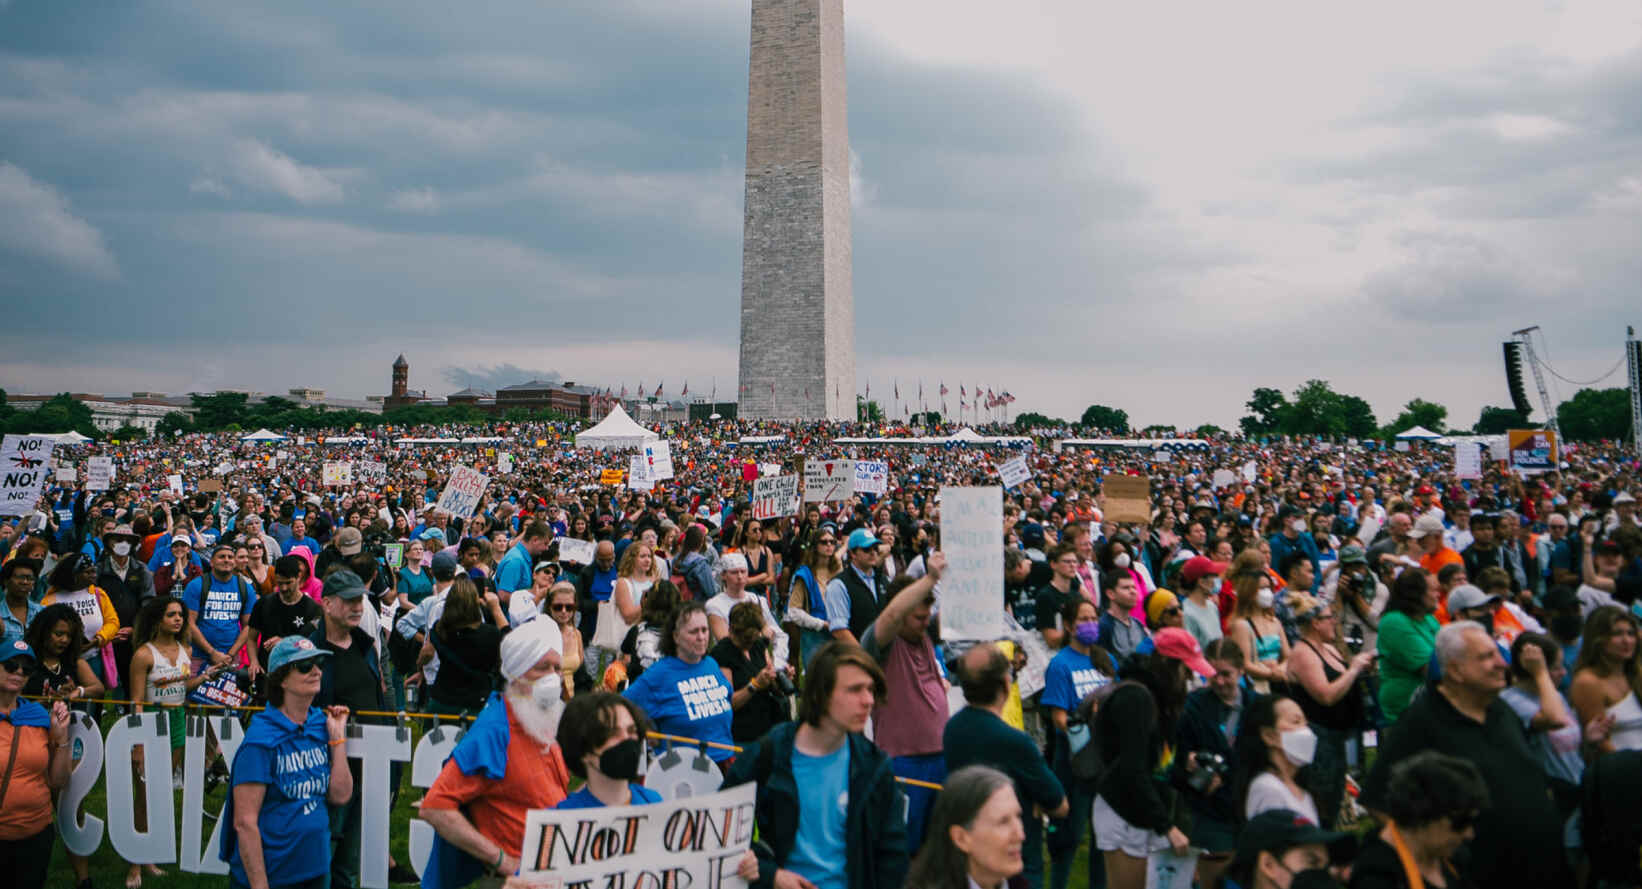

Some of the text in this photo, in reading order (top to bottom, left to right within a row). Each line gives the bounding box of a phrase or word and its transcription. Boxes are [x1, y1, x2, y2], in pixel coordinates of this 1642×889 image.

[17, 440, 42, 451] NO!
[3, 472, 38, 488] NO!
[758, 479, 774, 491] ONE
[754, 497, 776, 518] ALL
[207, 591, 238, 600] MARCH
[76, 599, 96, 608] VOICE
[204, 611, 229, 619] LIVES
[677, 674, 719, 694] MARCH
[663, 802, 754, 852] ONE
